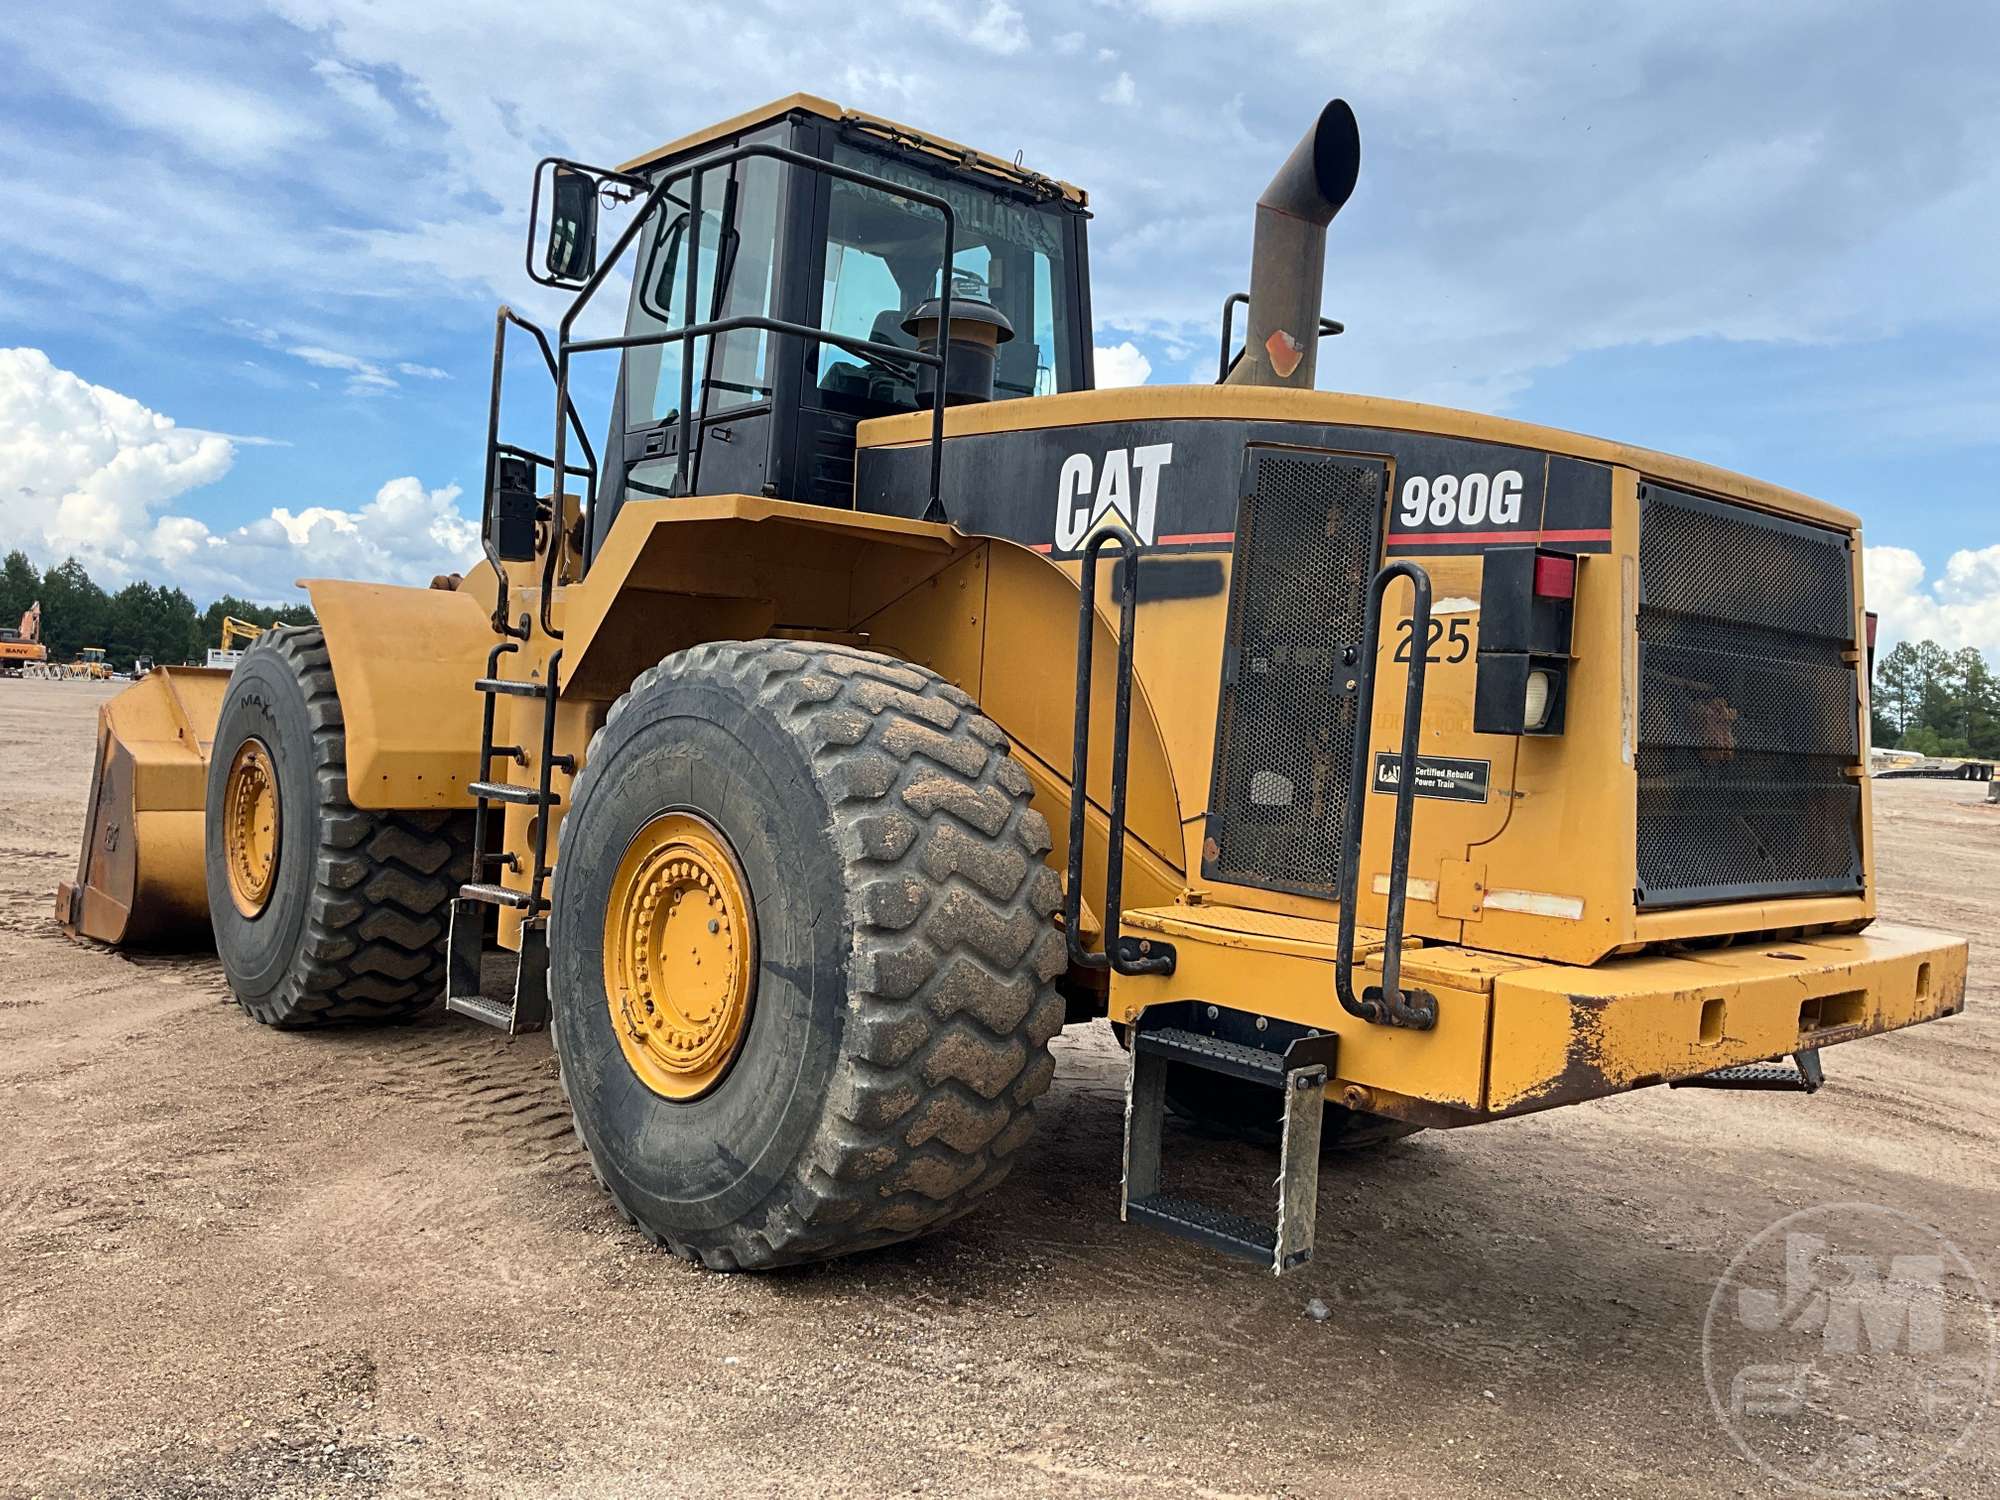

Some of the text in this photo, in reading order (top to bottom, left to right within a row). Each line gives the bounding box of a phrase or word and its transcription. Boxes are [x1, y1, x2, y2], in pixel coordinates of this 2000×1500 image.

[1055, 443, 1173, 551] CAT
[1400, 470, 1523, 527] 980G
[1393, 618, 1481, 664] 225
[1379, 764, 1401, 783] CAT
[1414, 778, 1455, 789] Power Train
[1415, 766, 1473, 780] Certified Rebuild
